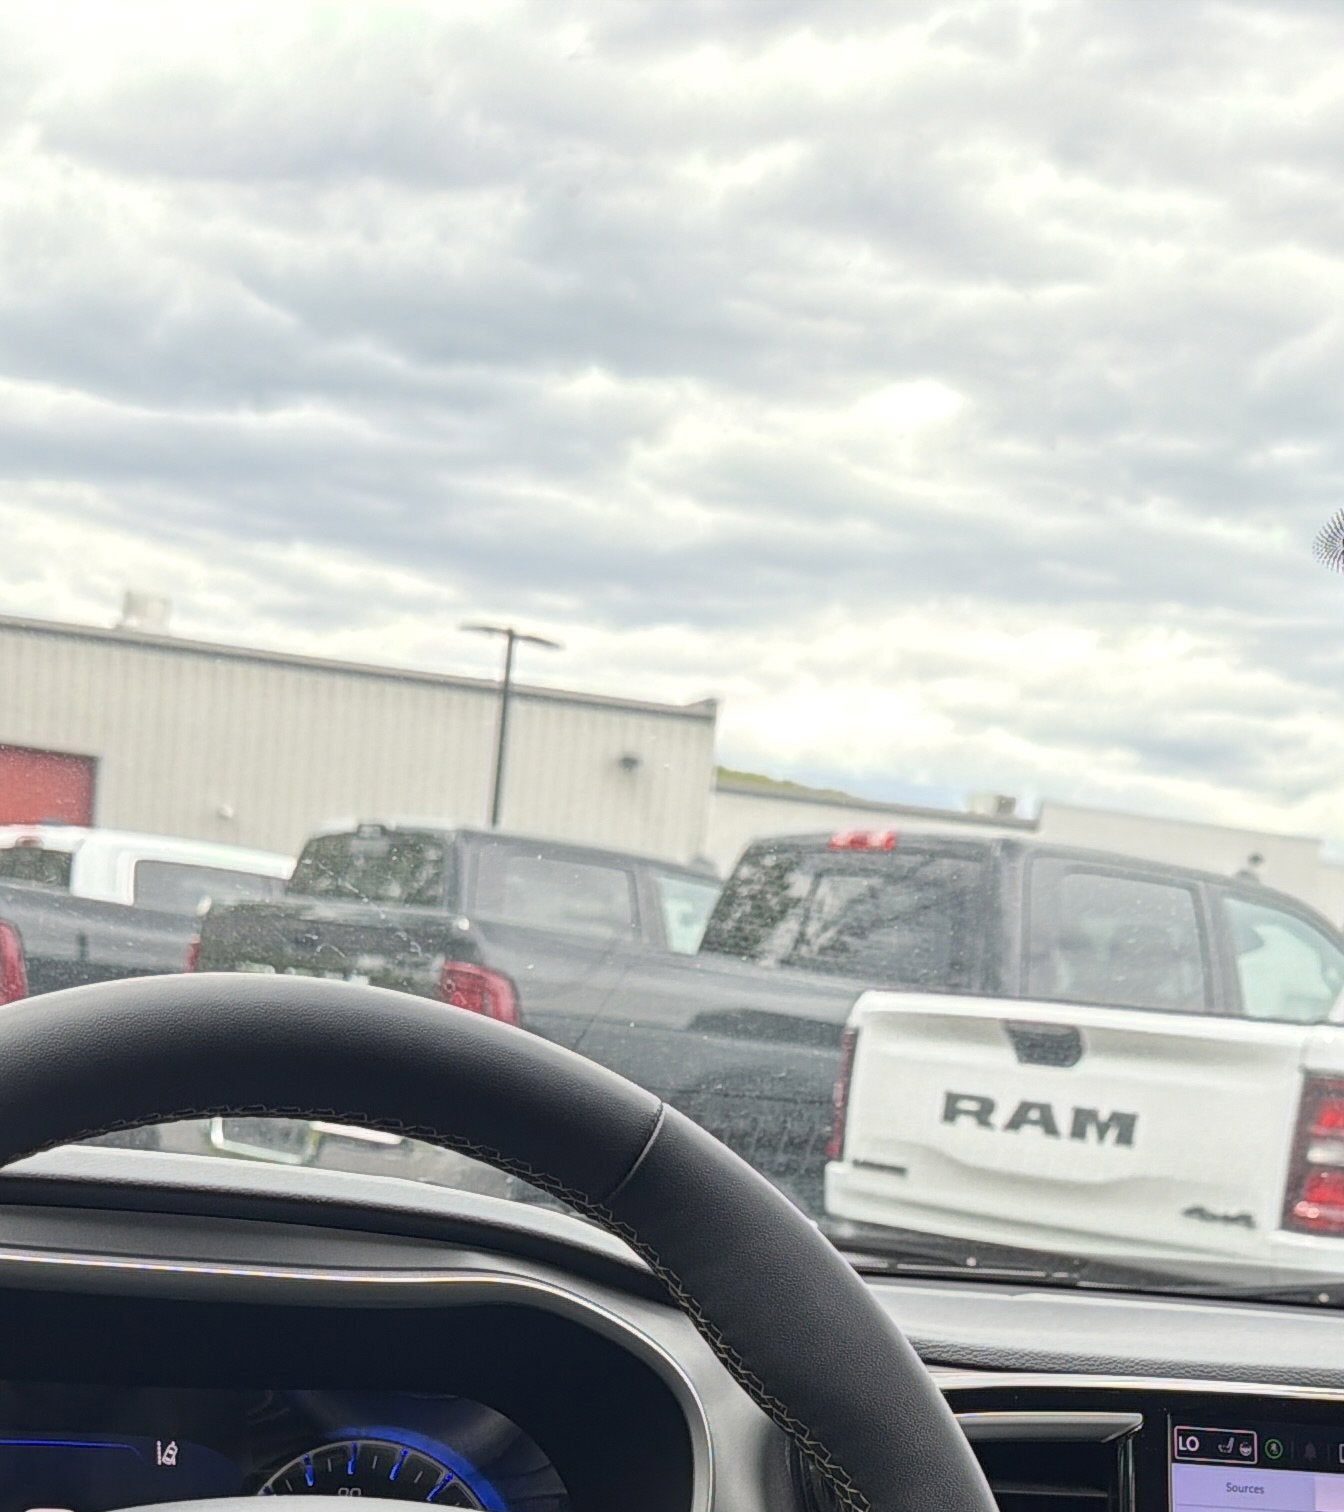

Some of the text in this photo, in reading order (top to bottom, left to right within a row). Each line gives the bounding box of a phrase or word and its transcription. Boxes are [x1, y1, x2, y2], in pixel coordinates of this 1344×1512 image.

[942, 1092, 1138, 1146] RAM
[1178, 1436, 1200, 1452] LO
[1225, 1481, 1265, 1495] Sources
